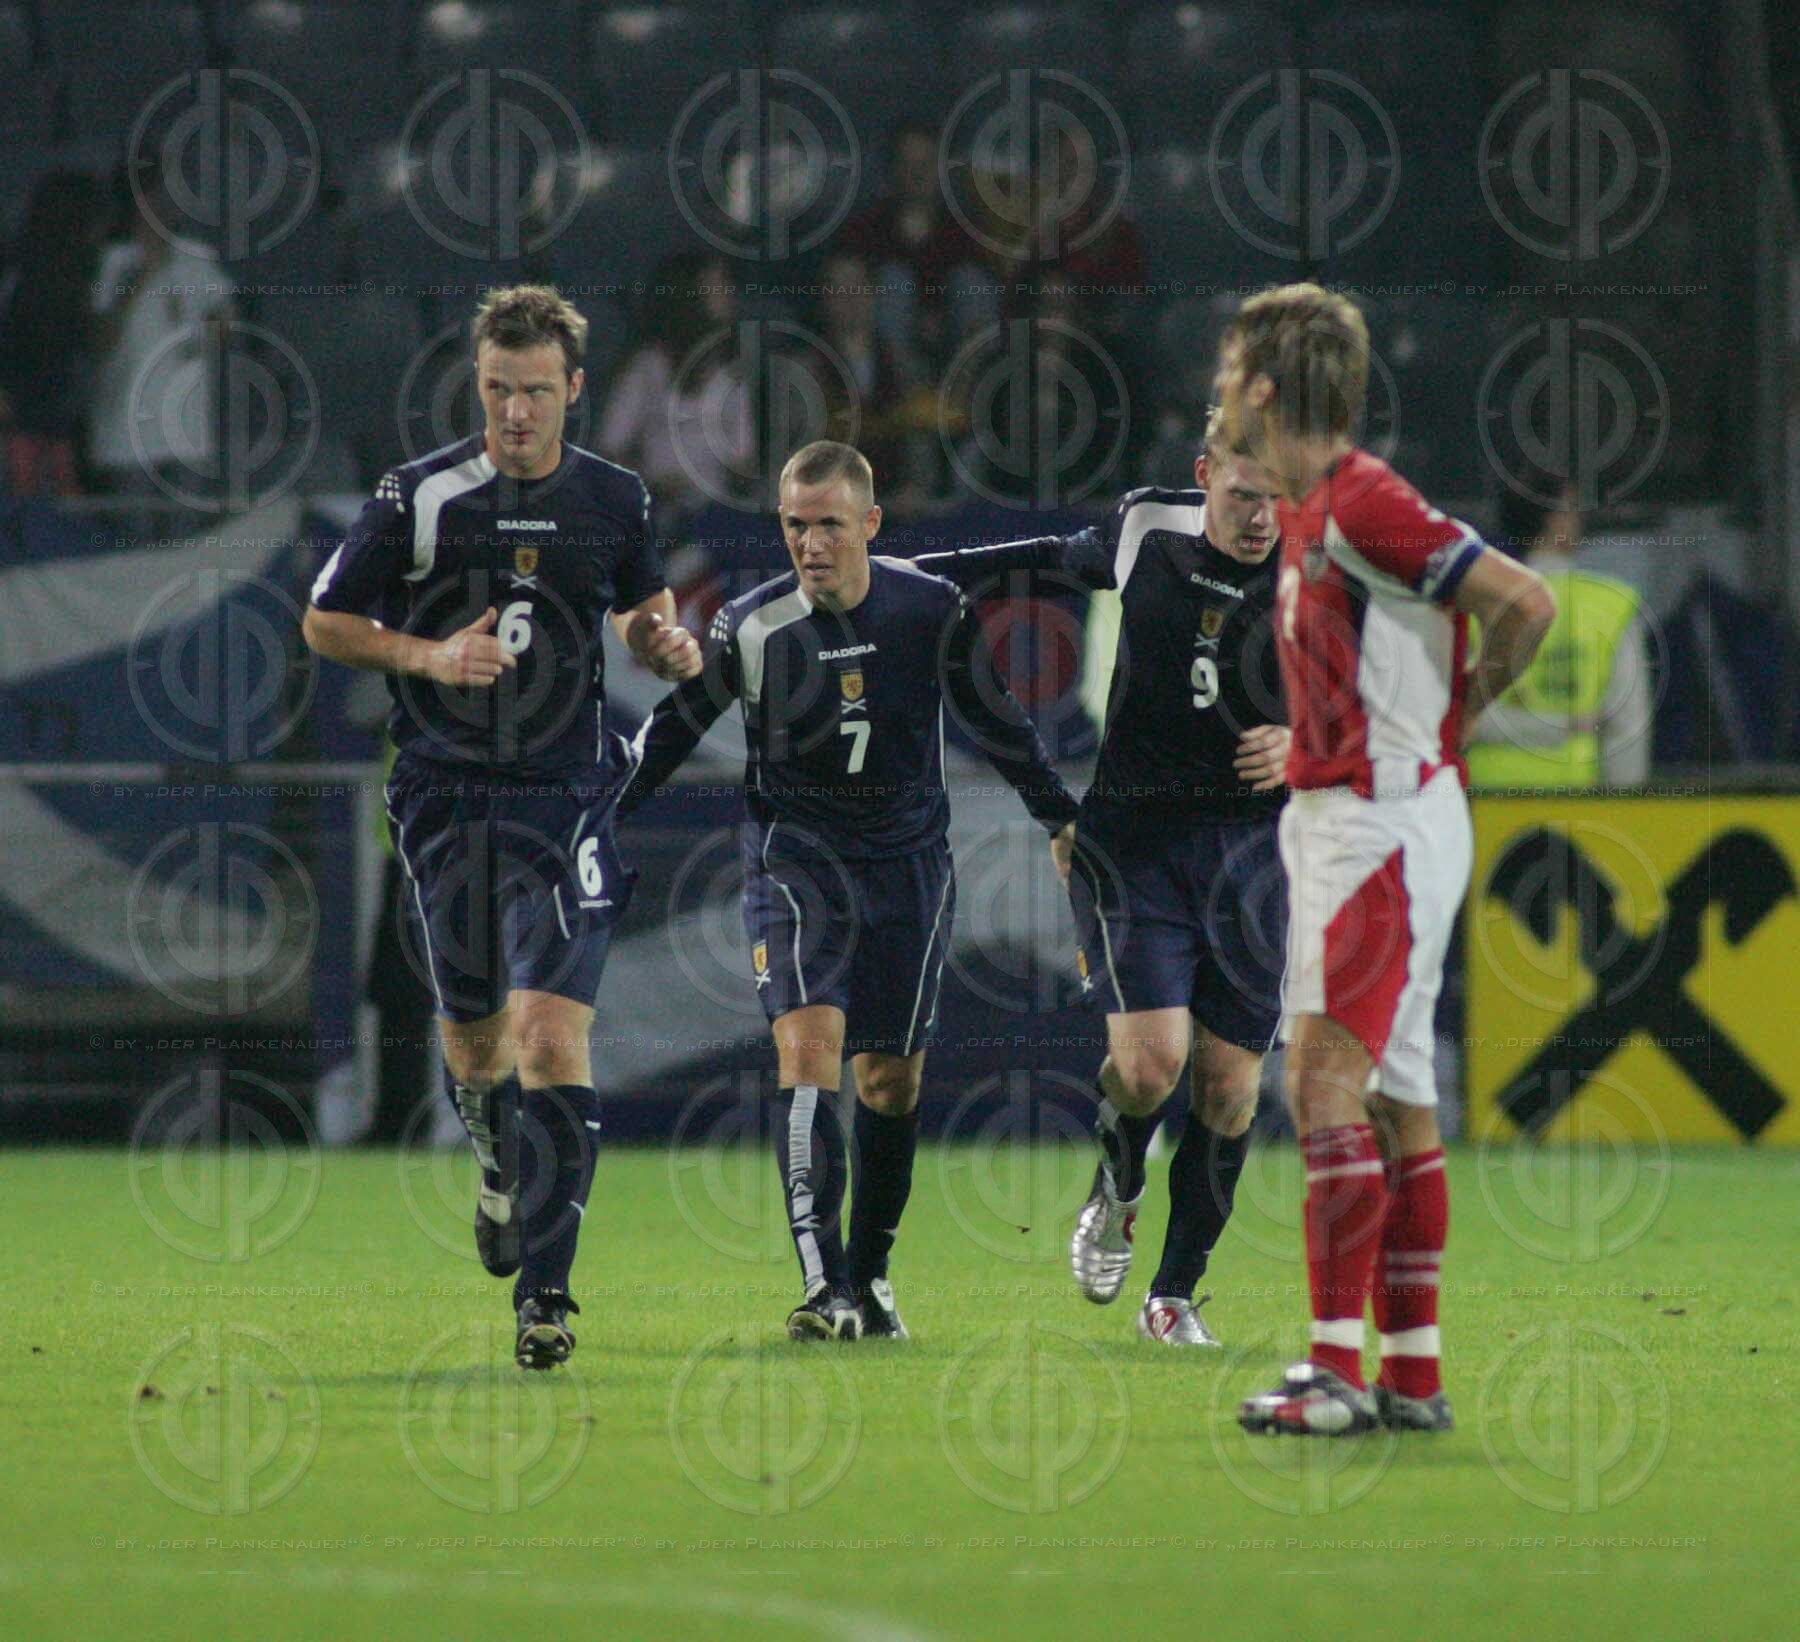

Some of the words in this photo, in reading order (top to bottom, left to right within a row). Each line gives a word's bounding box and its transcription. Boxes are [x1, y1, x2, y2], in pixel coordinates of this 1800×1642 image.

[497, 520, 557, 531] DIADORA
[1190, 573, 1245, 600] DIADORA
[498, 601, 534, 655] 6
[818, 643, 877, 661] DIADORA
[1190, 657, 1219, 709] 9
[840, 720, 871, 774] 7
[578, 836, 602, 897] 6
